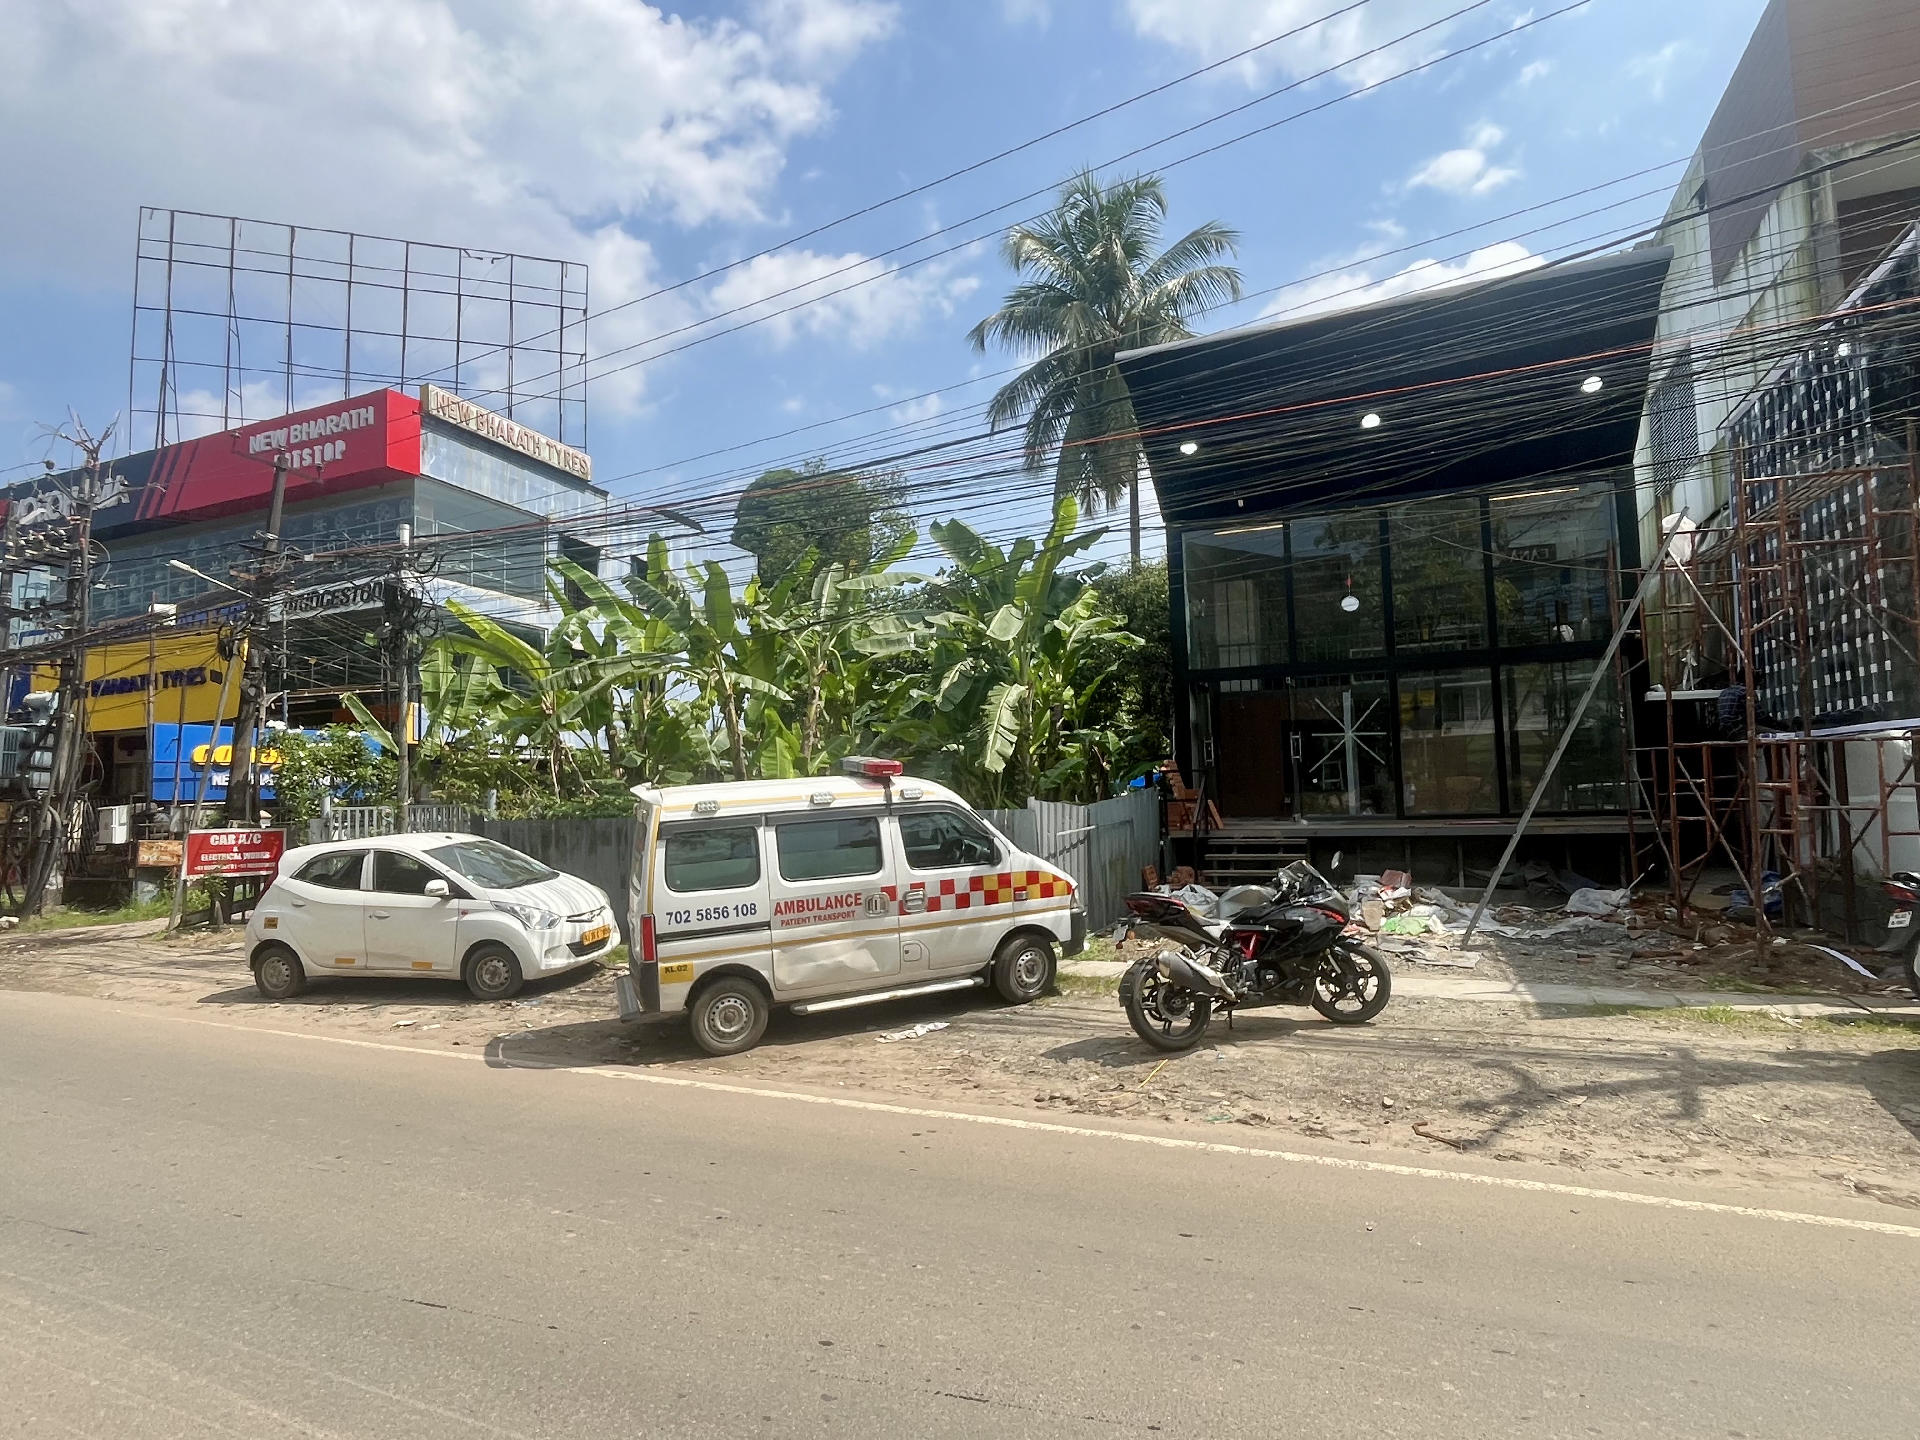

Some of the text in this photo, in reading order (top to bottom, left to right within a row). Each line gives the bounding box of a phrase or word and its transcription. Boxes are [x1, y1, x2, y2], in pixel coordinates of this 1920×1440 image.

[250, 405, 374, 454] NEW BHARATH
[436, 390, 590, 476] NEW BHARATH TYRES
[210, 833, 262, 846] CAR A/C
[665, 902, 757, 925] 702 5856 108
[774, 892, 863, 917] AMBULANCE
[781, 910, 856, 927] PATIENT TRANSPORT
